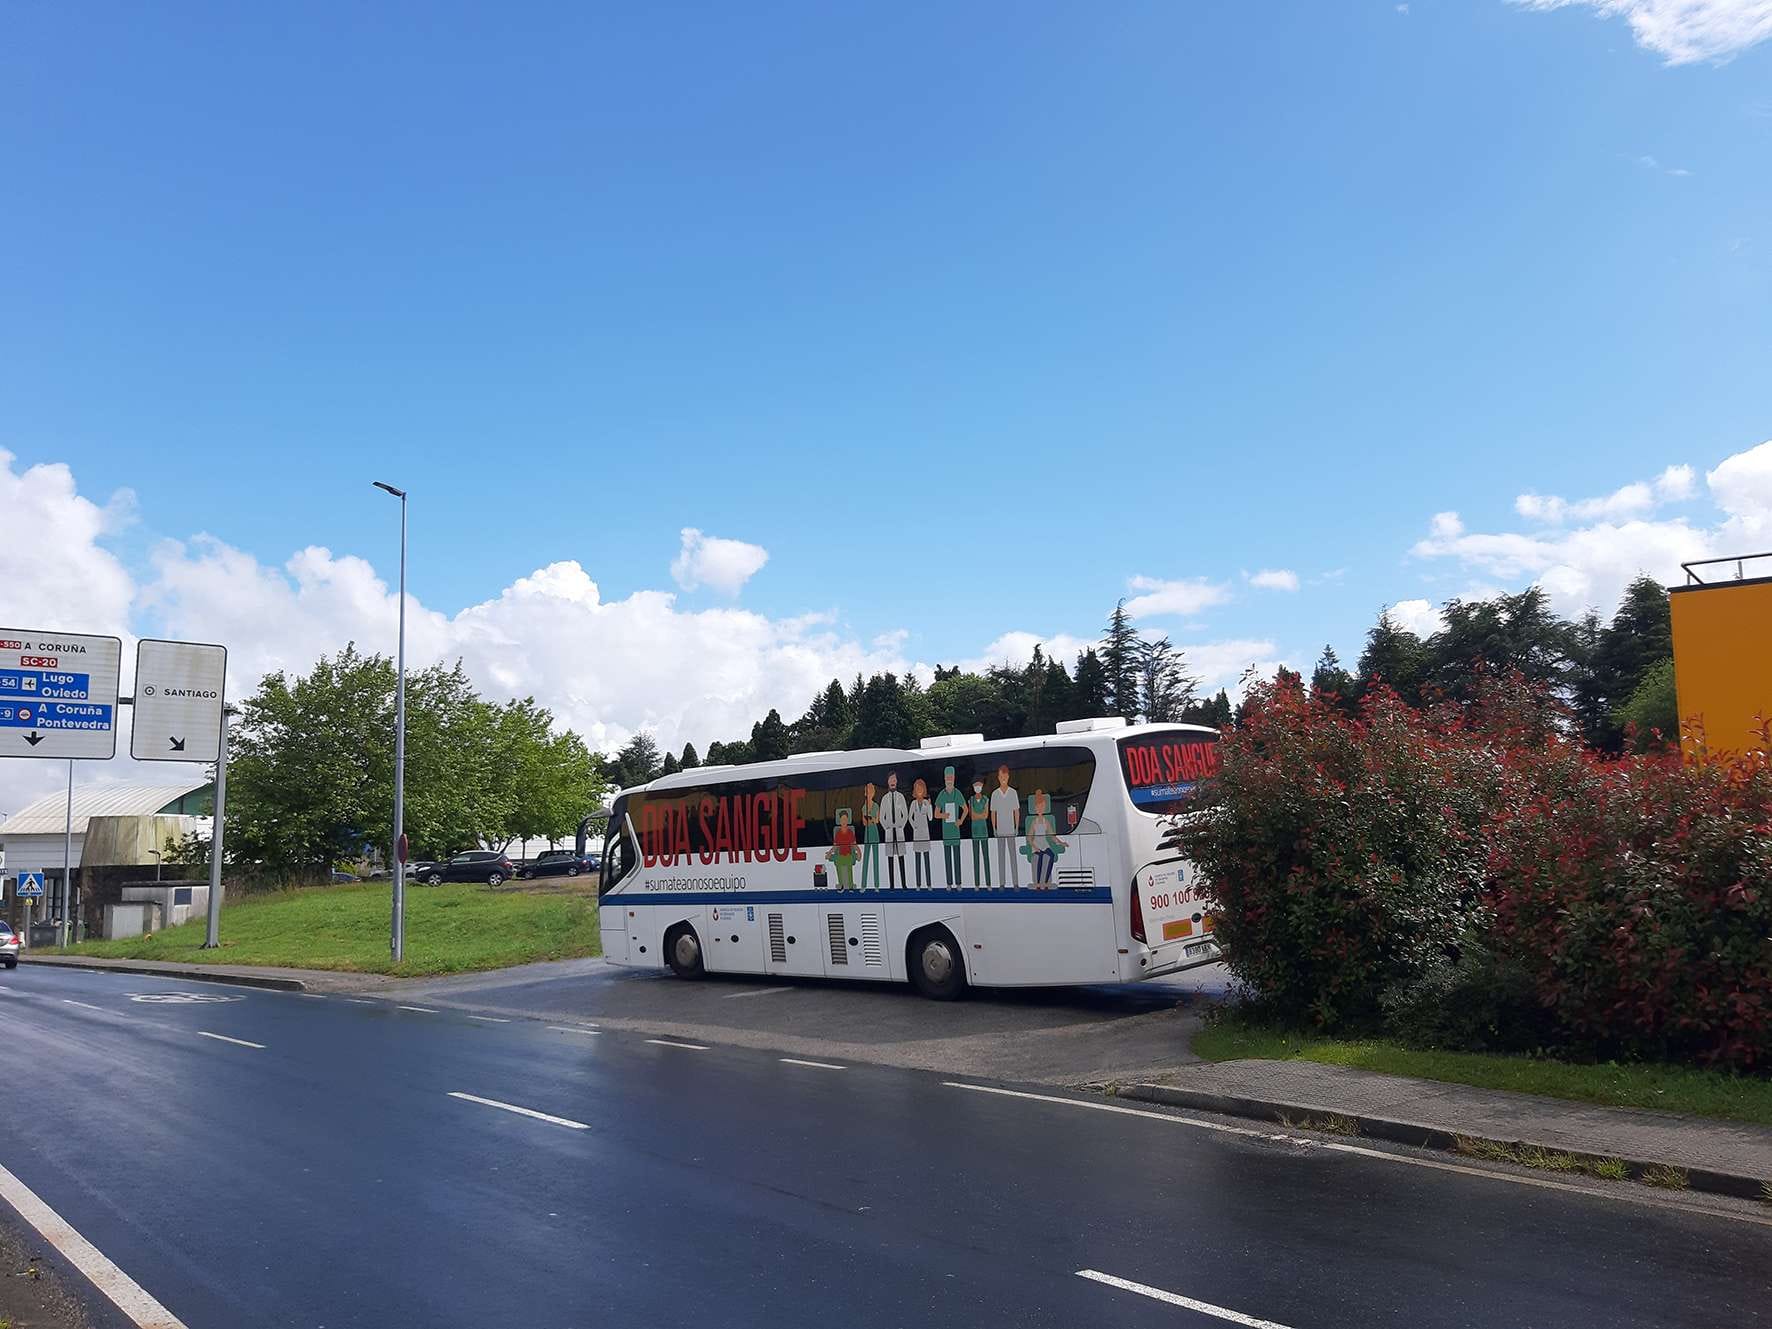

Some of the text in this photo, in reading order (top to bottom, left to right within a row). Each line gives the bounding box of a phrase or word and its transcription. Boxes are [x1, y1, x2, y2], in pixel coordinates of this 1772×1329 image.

[39, 643, 87, 654] CORUÑA
[22, 657, 57, 667] SC-20
[42, 672, 74, 685] Lugo
[42, 687, 87, 699] Oviedo
[164, 688, 218, 699] SANTIAGO
[39, 704, 103, 716] A Coruña
[37, 717, 109, 730] Pontevedra
[1126, 746, 1164, 785] DOA
[642, 788, 808, 868] DOA SANGUE
[1151, 894, 1170, 910] 900
[1173, 890, 1191, 905] 100
